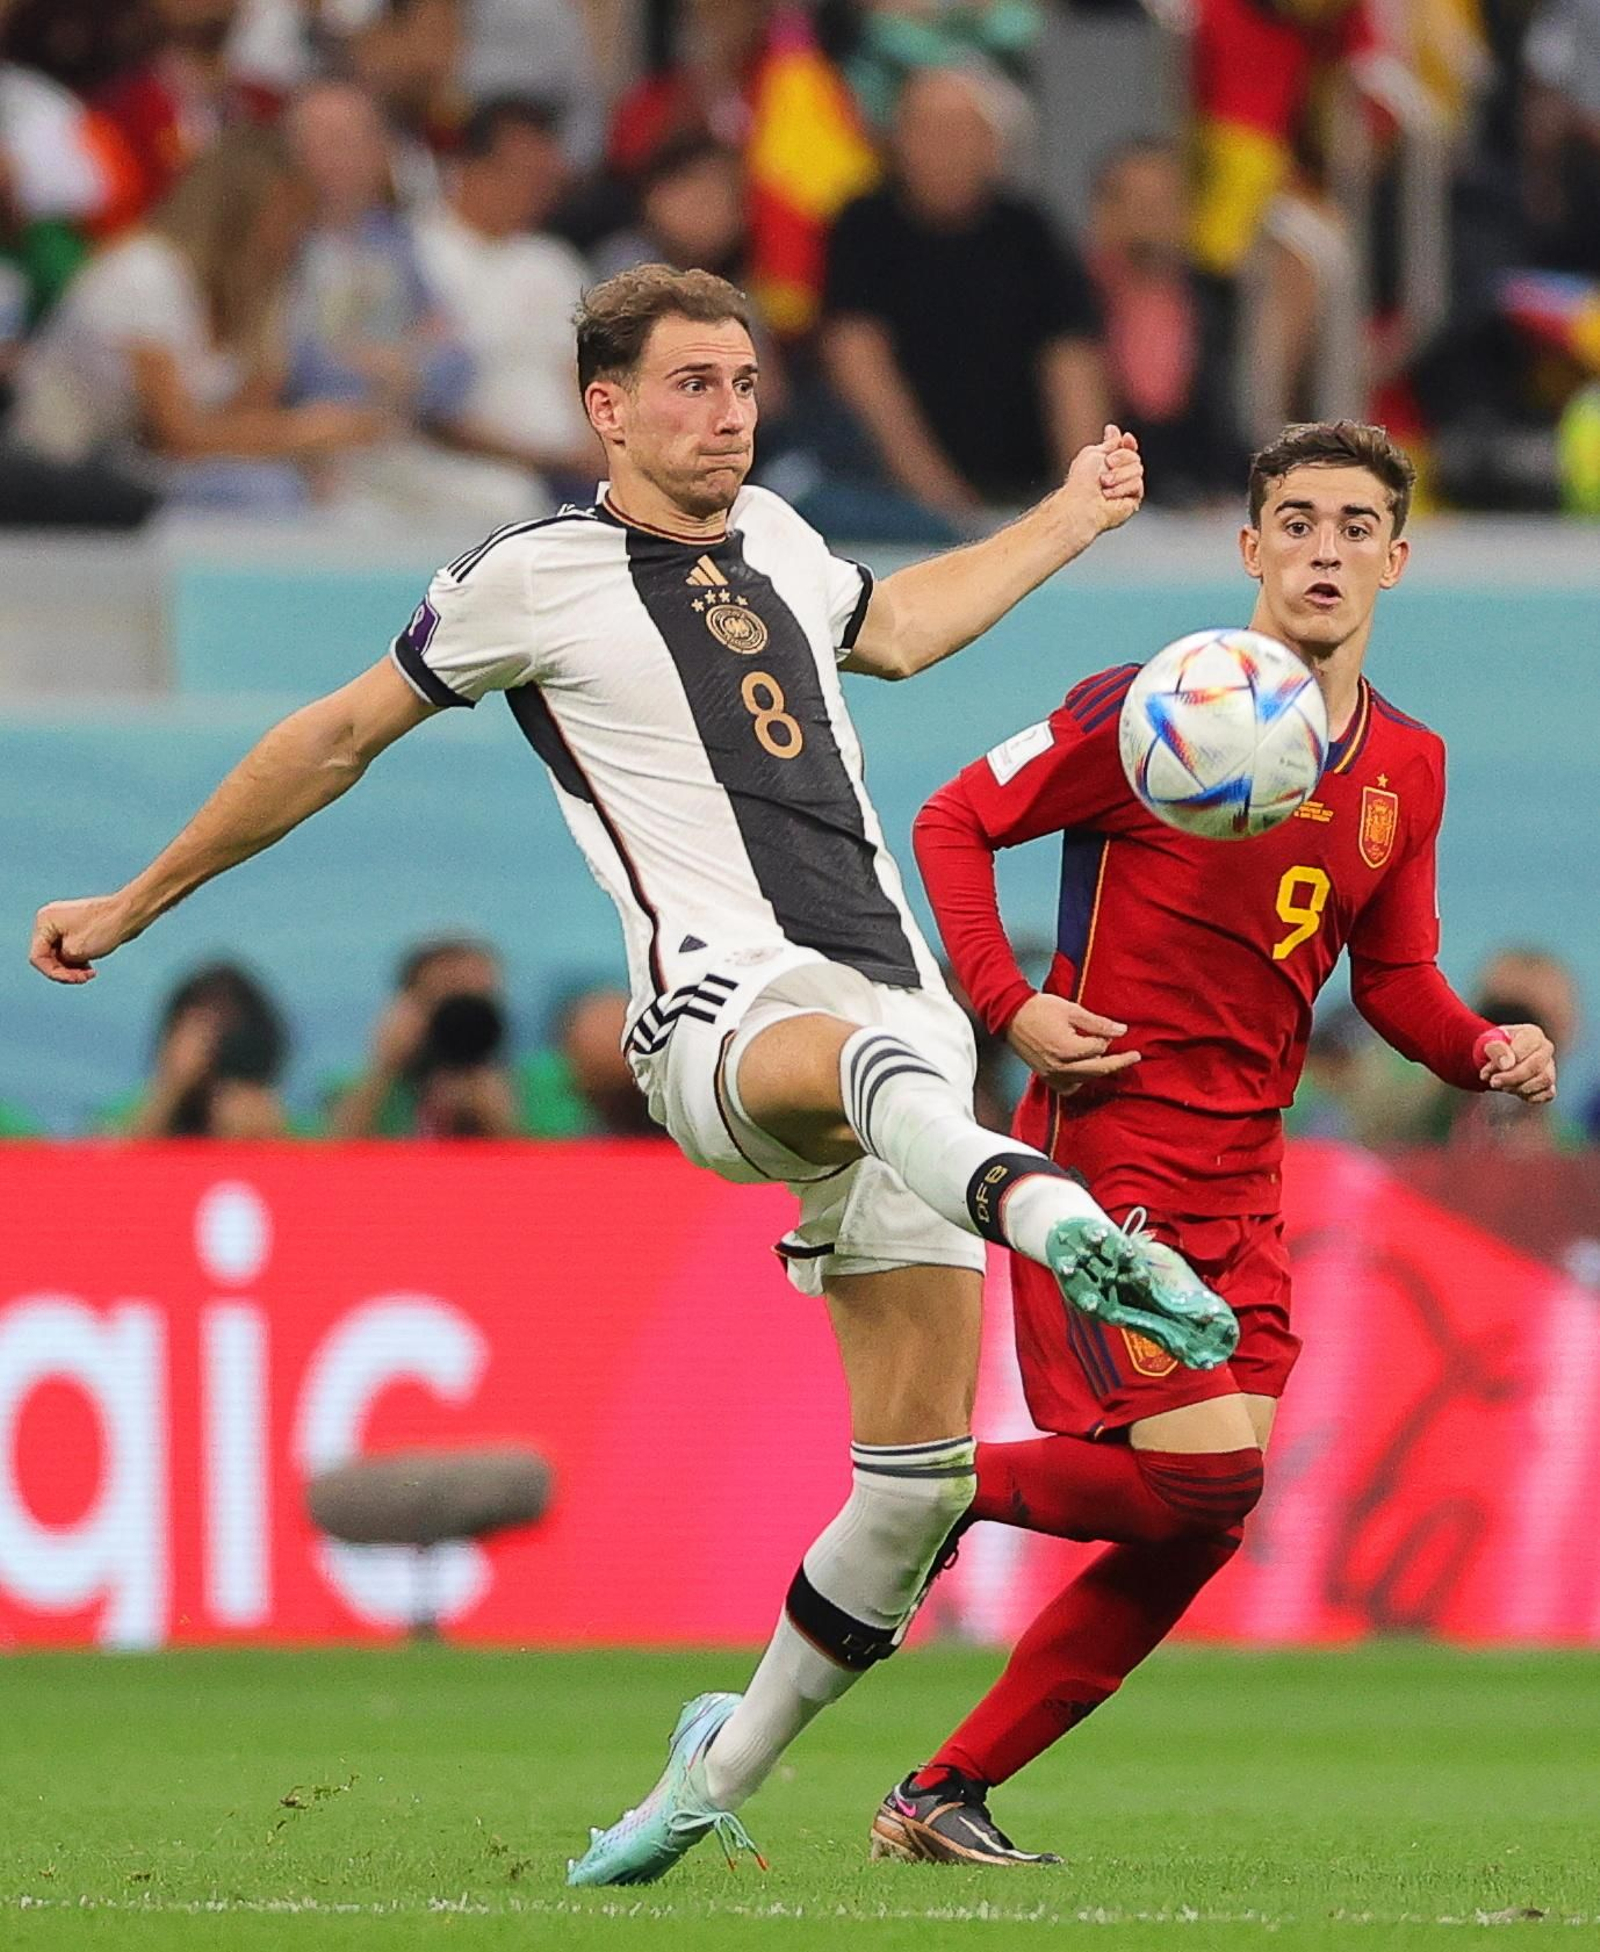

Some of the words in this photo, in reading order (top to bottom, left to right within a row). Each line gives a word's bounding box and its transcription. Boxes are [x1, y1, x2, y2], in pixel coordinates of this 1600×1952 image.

[741, 671, 803, 759] 8
[1272, 865, 1331, 960] 9
[975, 1165, 1009, 1223] DFB
